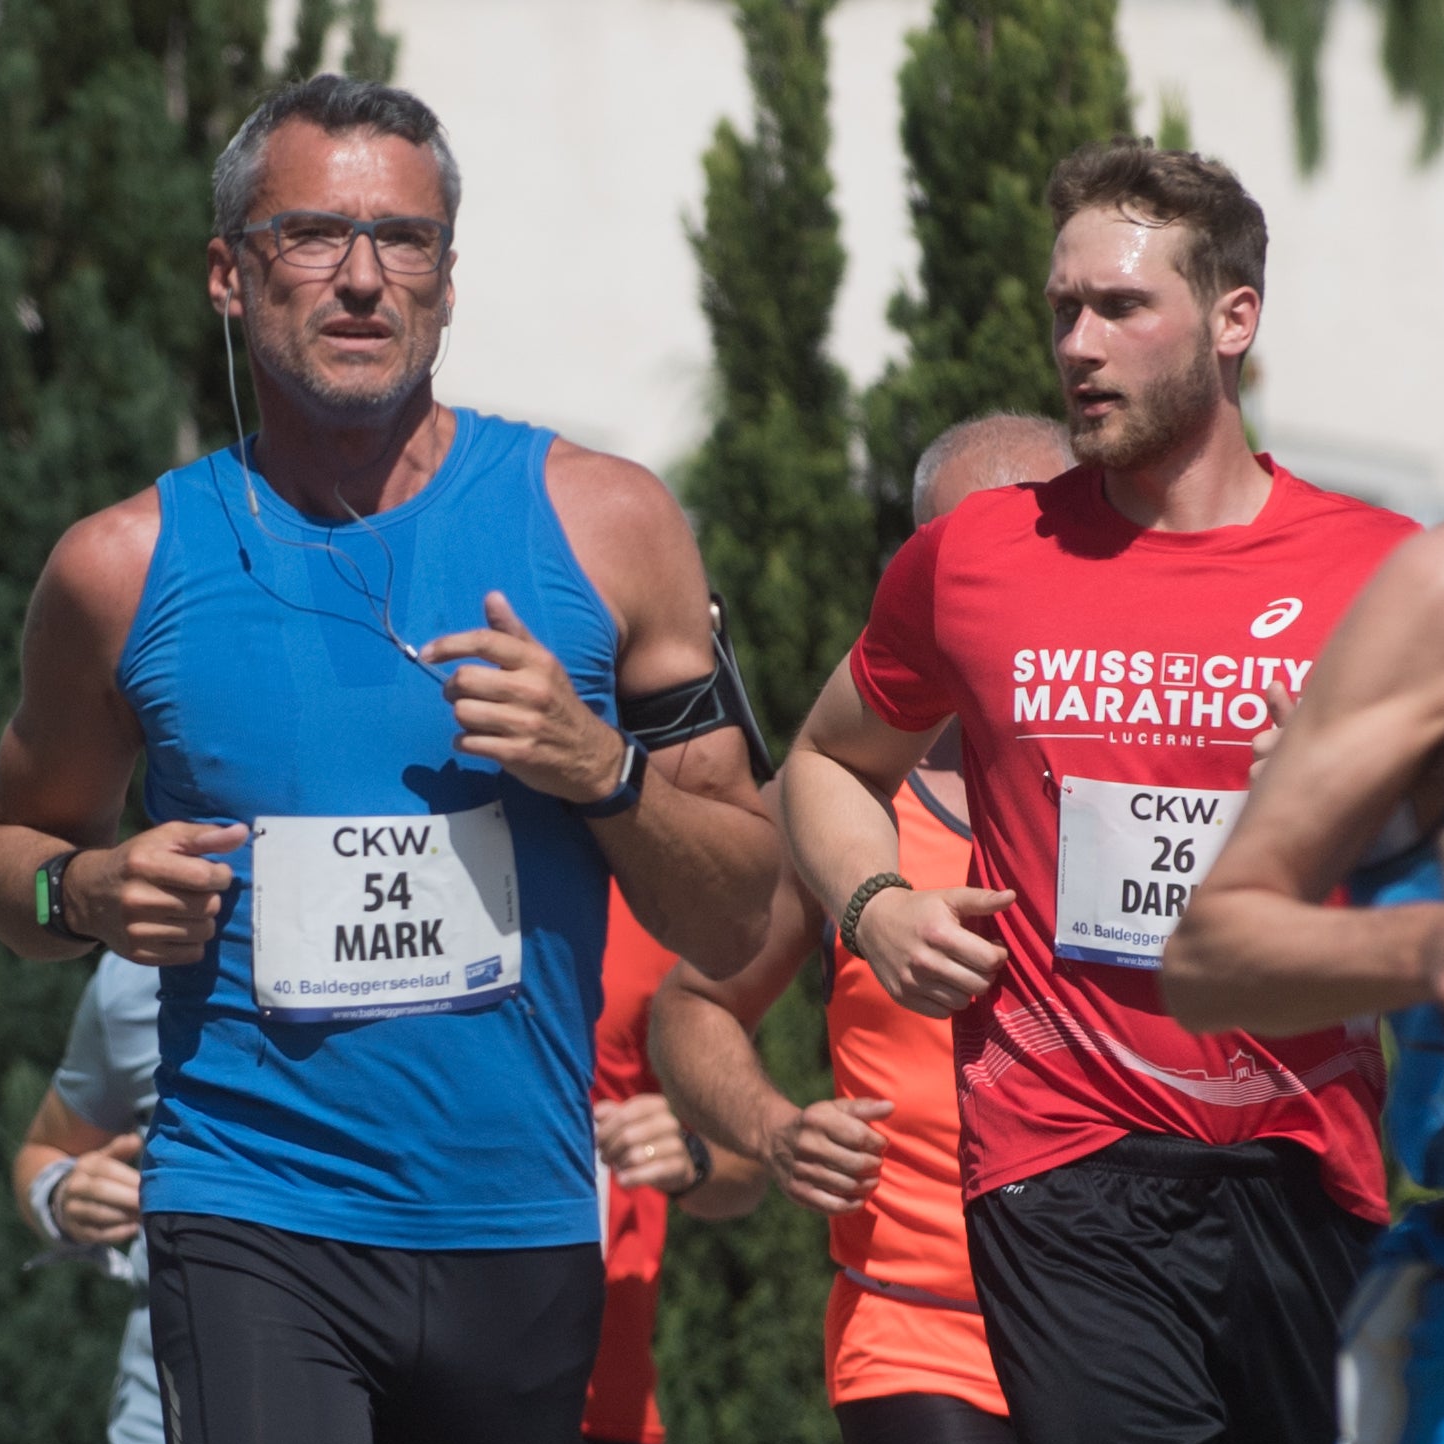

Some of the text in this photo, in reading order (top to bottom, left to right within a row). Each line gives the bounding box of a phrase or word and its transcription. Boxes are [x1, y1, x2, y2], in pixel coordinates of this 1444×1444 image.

[1013, 648, 1312, 693] SWISS CITY
[1013, 685, 1302, 730] MARATHO
[1109, 731, 1206, 748] LUCERNE
[1150, 836, 1196, 873] 26
[363, 871, 413, 912] 54
[334, 919, 444, 962] MARK
[1071, 922, 1168, 946] 40. Baldegger
[273, 971, 451, 996] 40. Baldeggerseelauf
